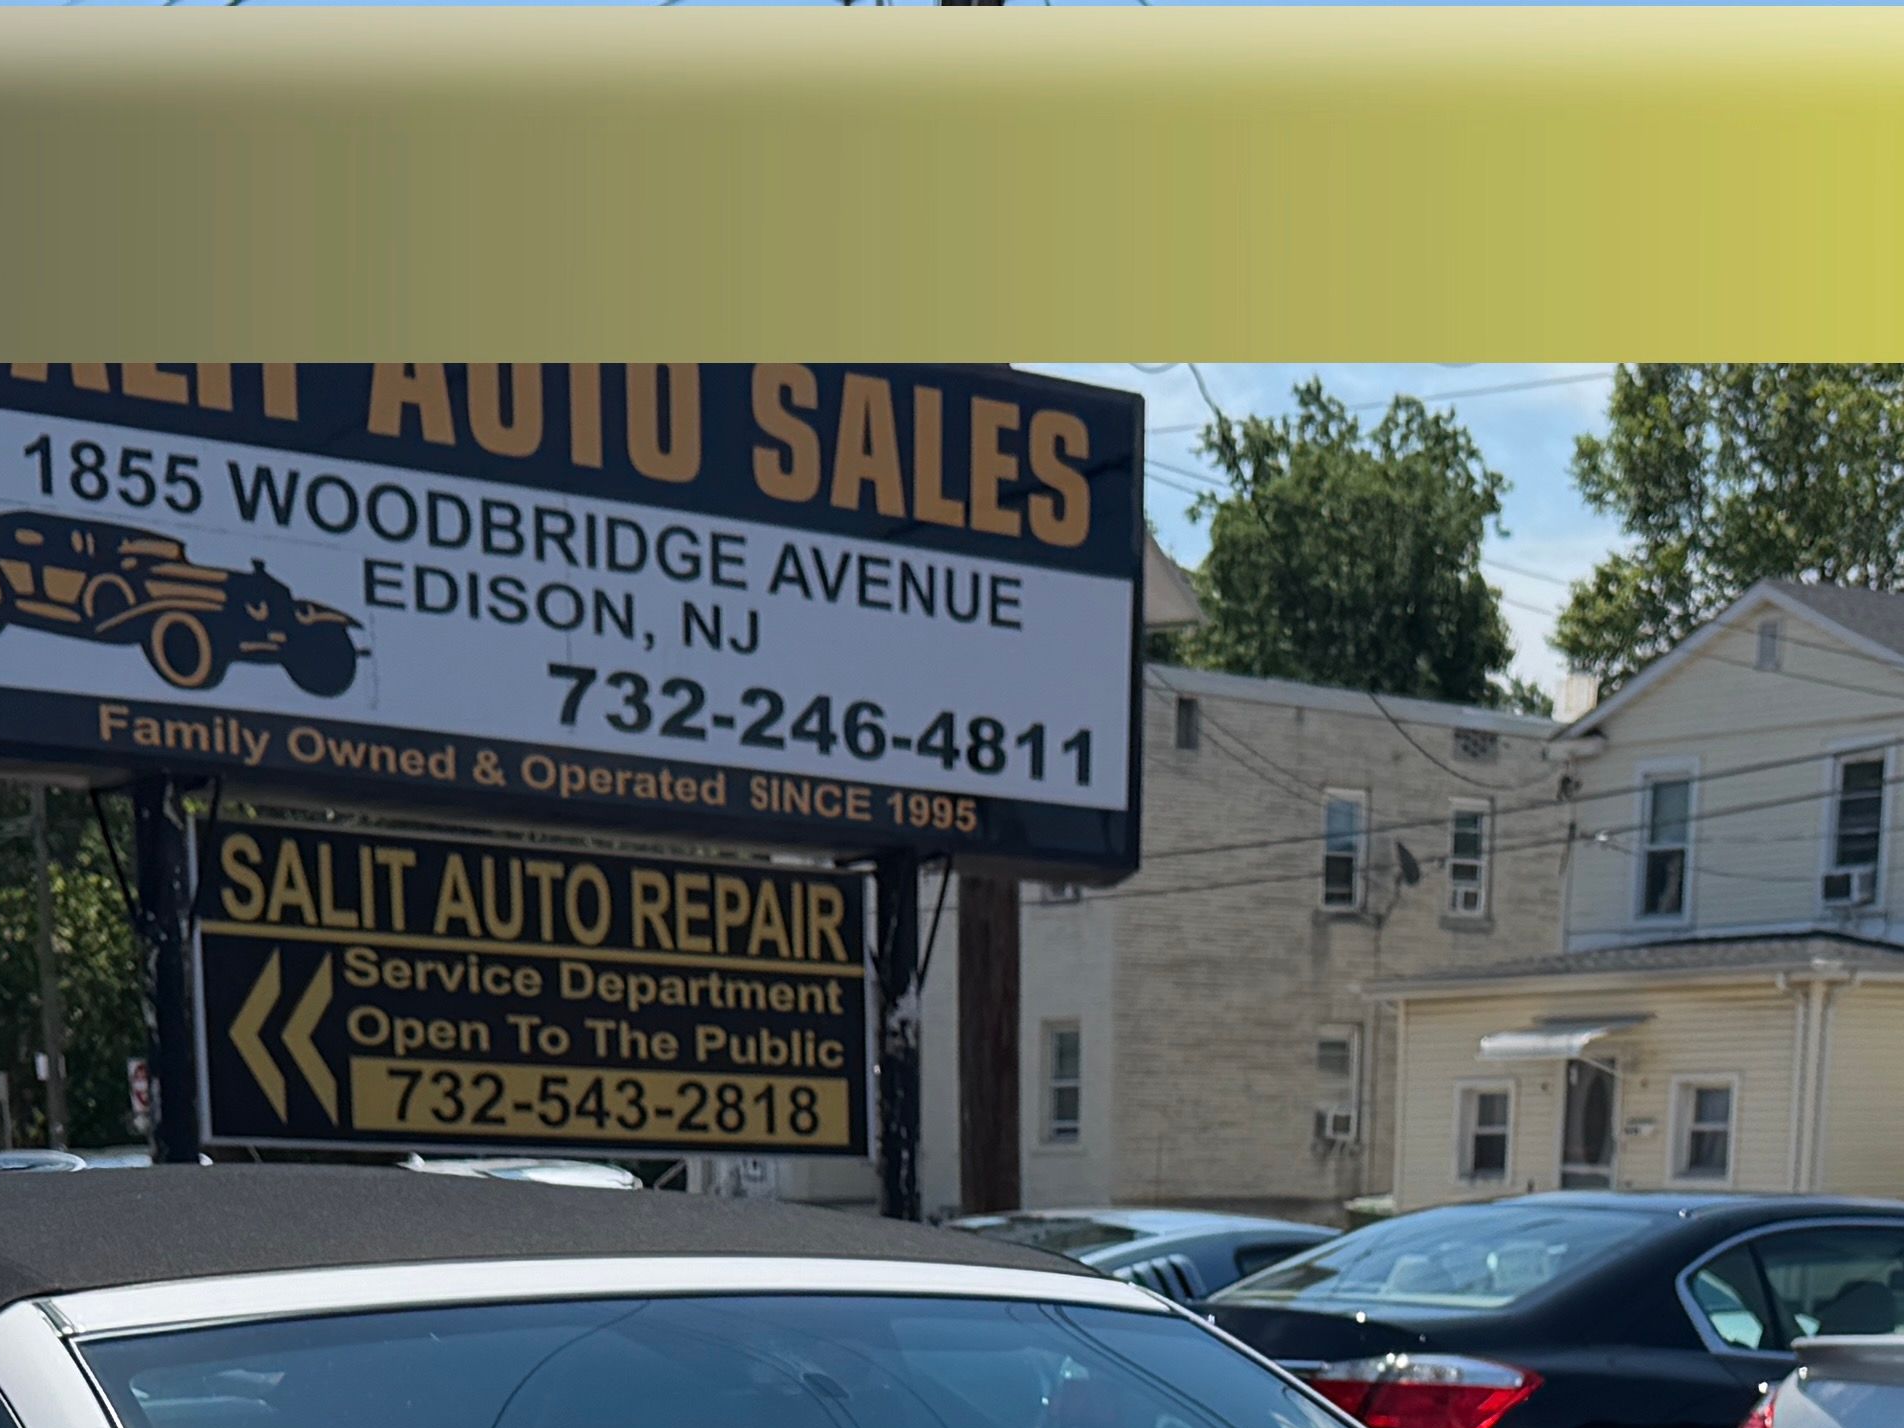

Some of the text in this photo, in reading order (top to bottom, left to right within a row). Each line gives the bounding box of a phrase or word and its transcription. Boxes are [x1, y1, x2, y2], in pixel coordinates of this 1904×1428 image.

[751, 363, 1090, 548] SALES
[24, 434, 1023, 631] 1855 WOODBRIDGE AVENUE
[363, 558, 760, 655] EDISON, NJ
[98, 704, 978, 833] Family Owned & Operated SINCE 1995
[547, 662, 1094, 787] 732-246-4811
[220, 833, 850, 963] SALIT AUTO REPAIR
[344, 946, 844, 1015] Service Department
[346, 1006, 846, 1068] Open To The Public
[386, 1068, 820, 1138] 732-543-2818
